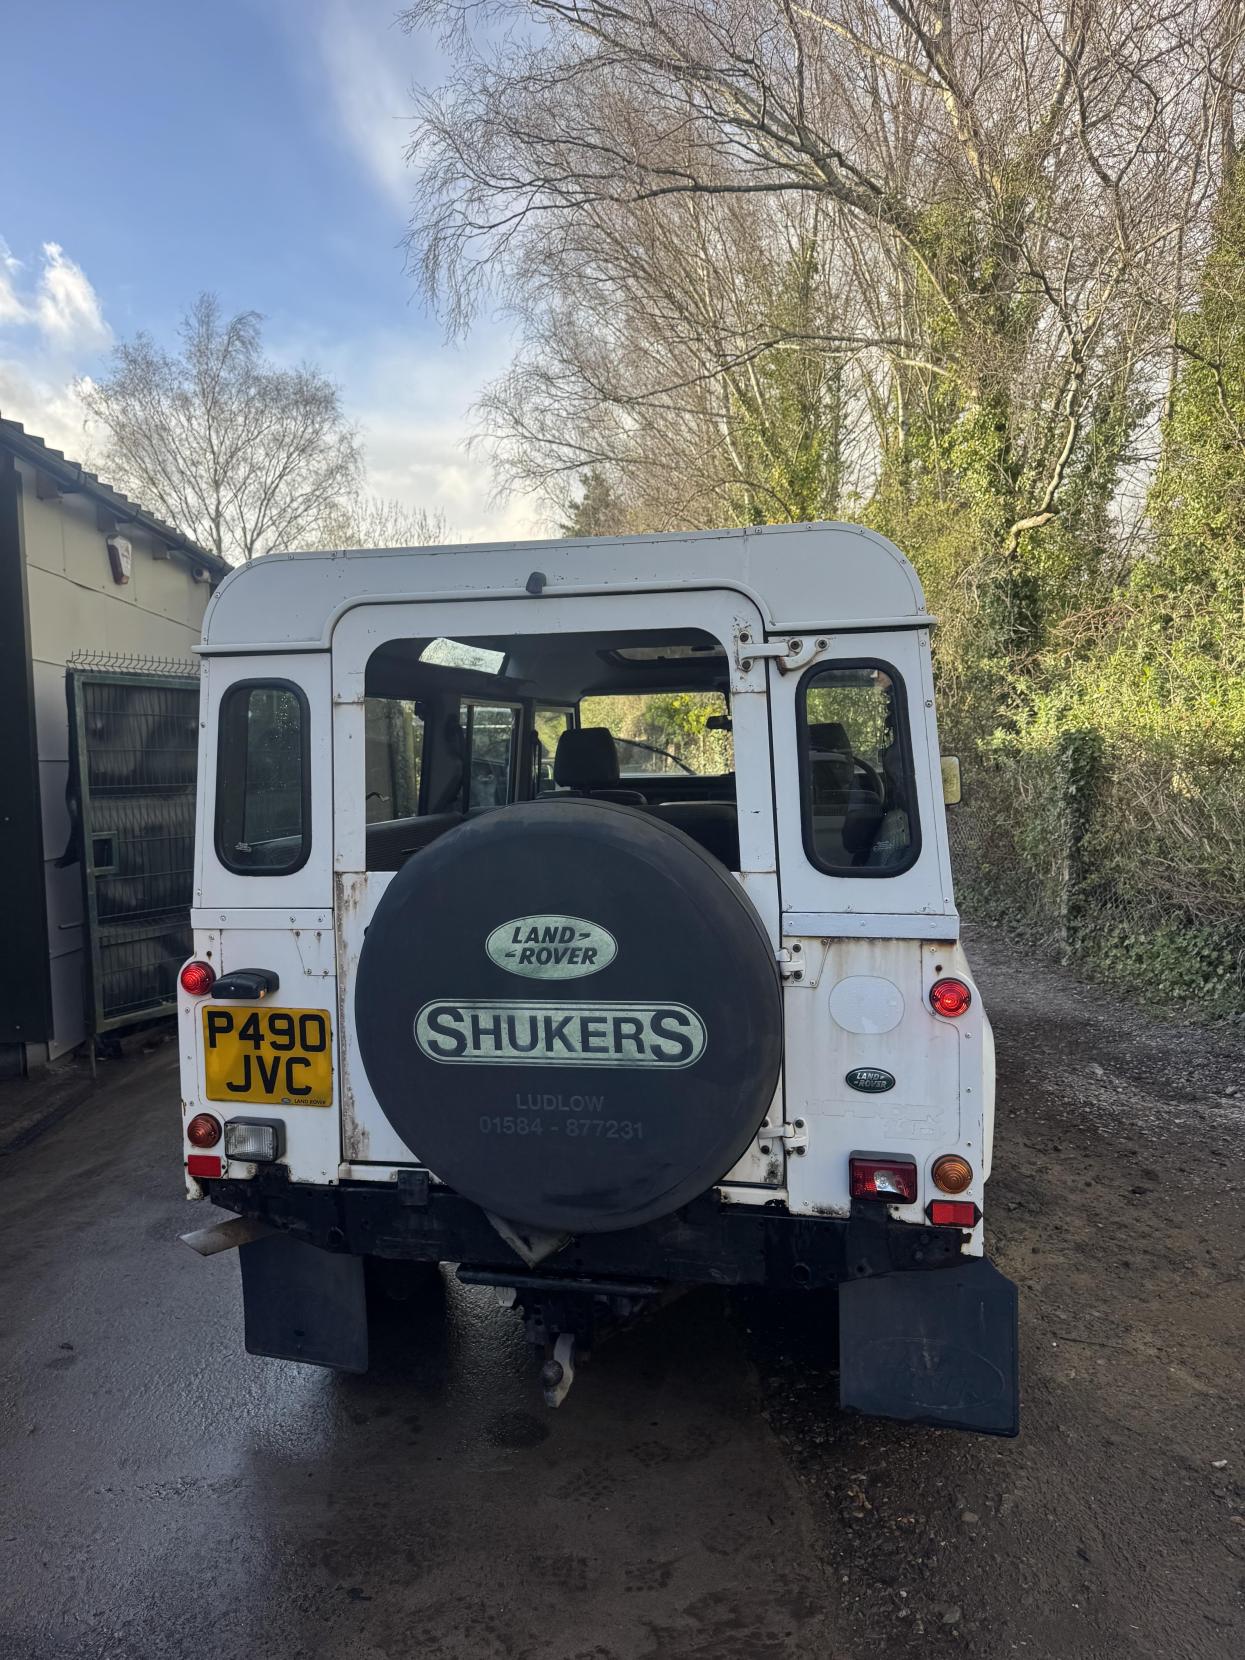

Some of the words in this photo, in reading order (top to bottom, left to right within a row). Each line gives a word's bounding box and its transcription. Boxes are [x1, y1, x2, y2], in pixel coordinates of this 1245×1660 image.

[207, 1010, 326, 1052] P490
[426, 1006, 694, 1063] SHUKERS
[226, 1055, 312, 1095] JVC
[515, 1093, 604, 1112] LUDLOW
[479, 1115, 543, 1135] 01584
[565, 1118, 644, 1140] 877231
